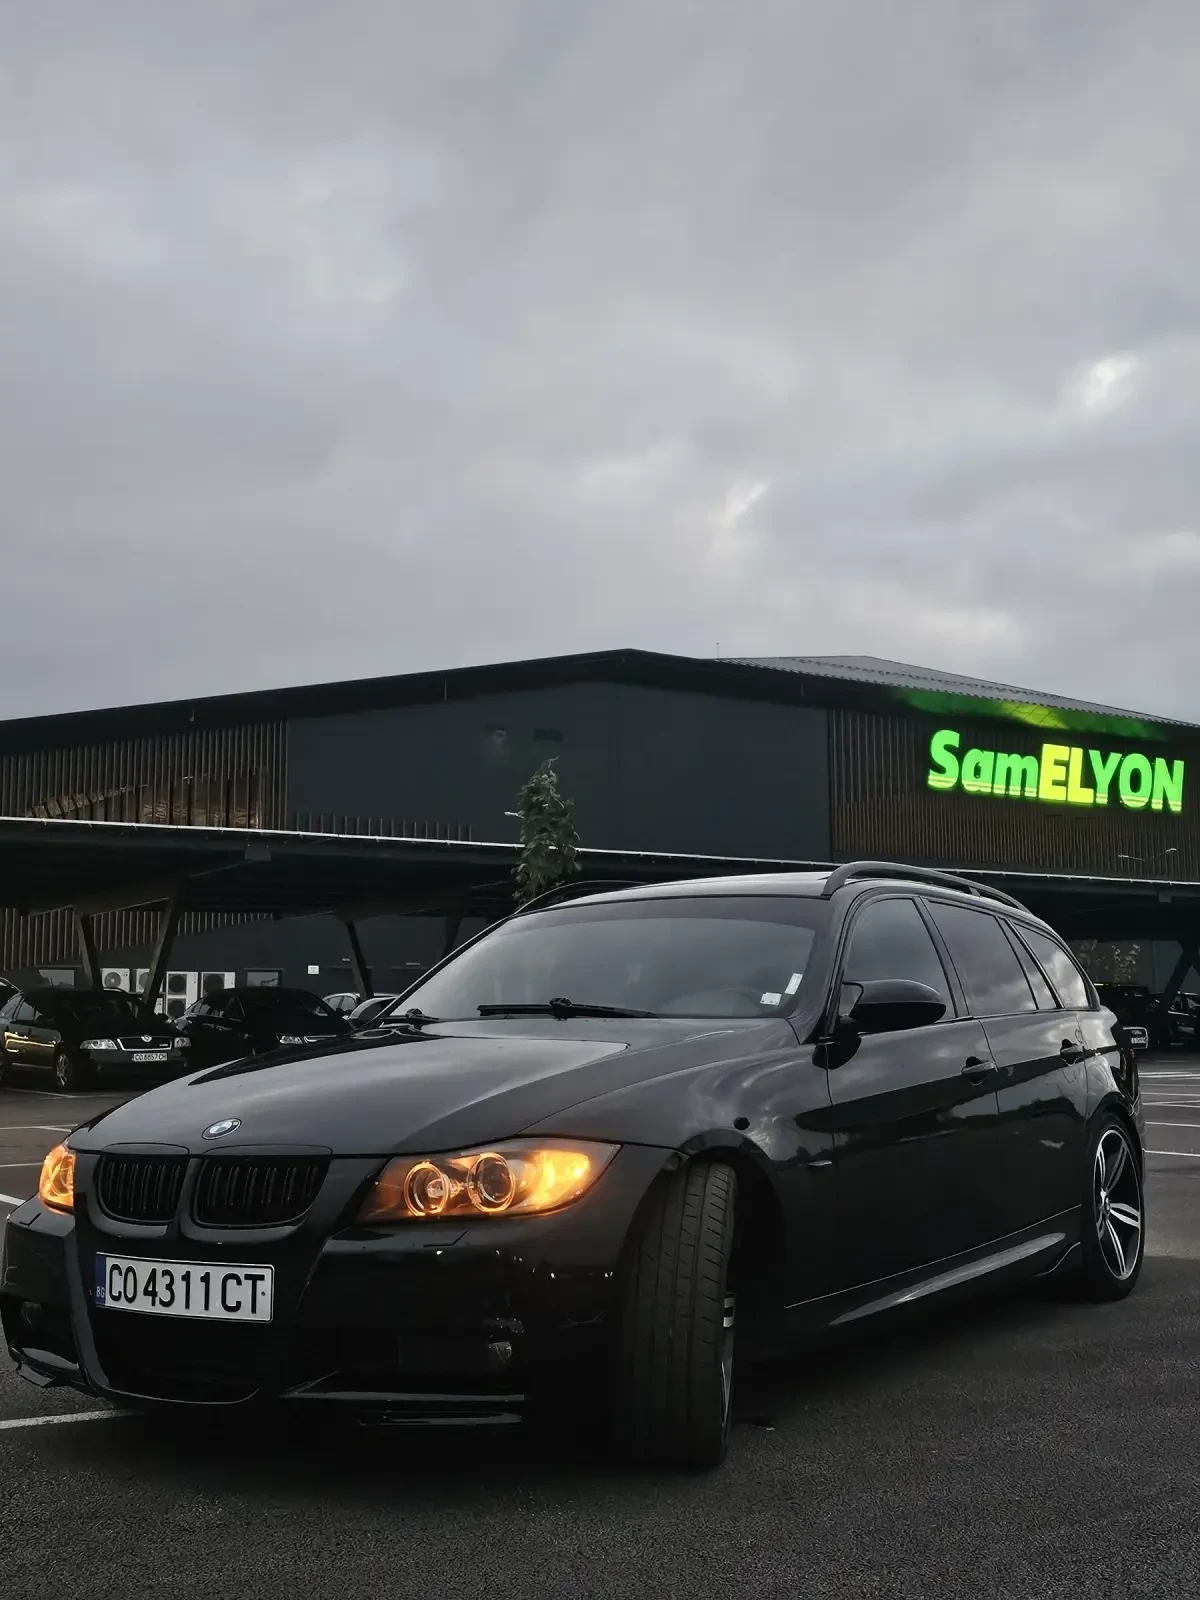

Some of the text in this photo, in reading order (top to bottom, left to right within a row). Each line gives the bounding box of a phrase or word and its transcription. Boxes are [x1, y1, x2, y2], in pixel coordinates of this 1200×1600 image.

[928, 729, 1185, 812] SamELYON
[96, 1286, 106, 1298] BG
[109, 1263, 266, 1314] CO 4311 CT
